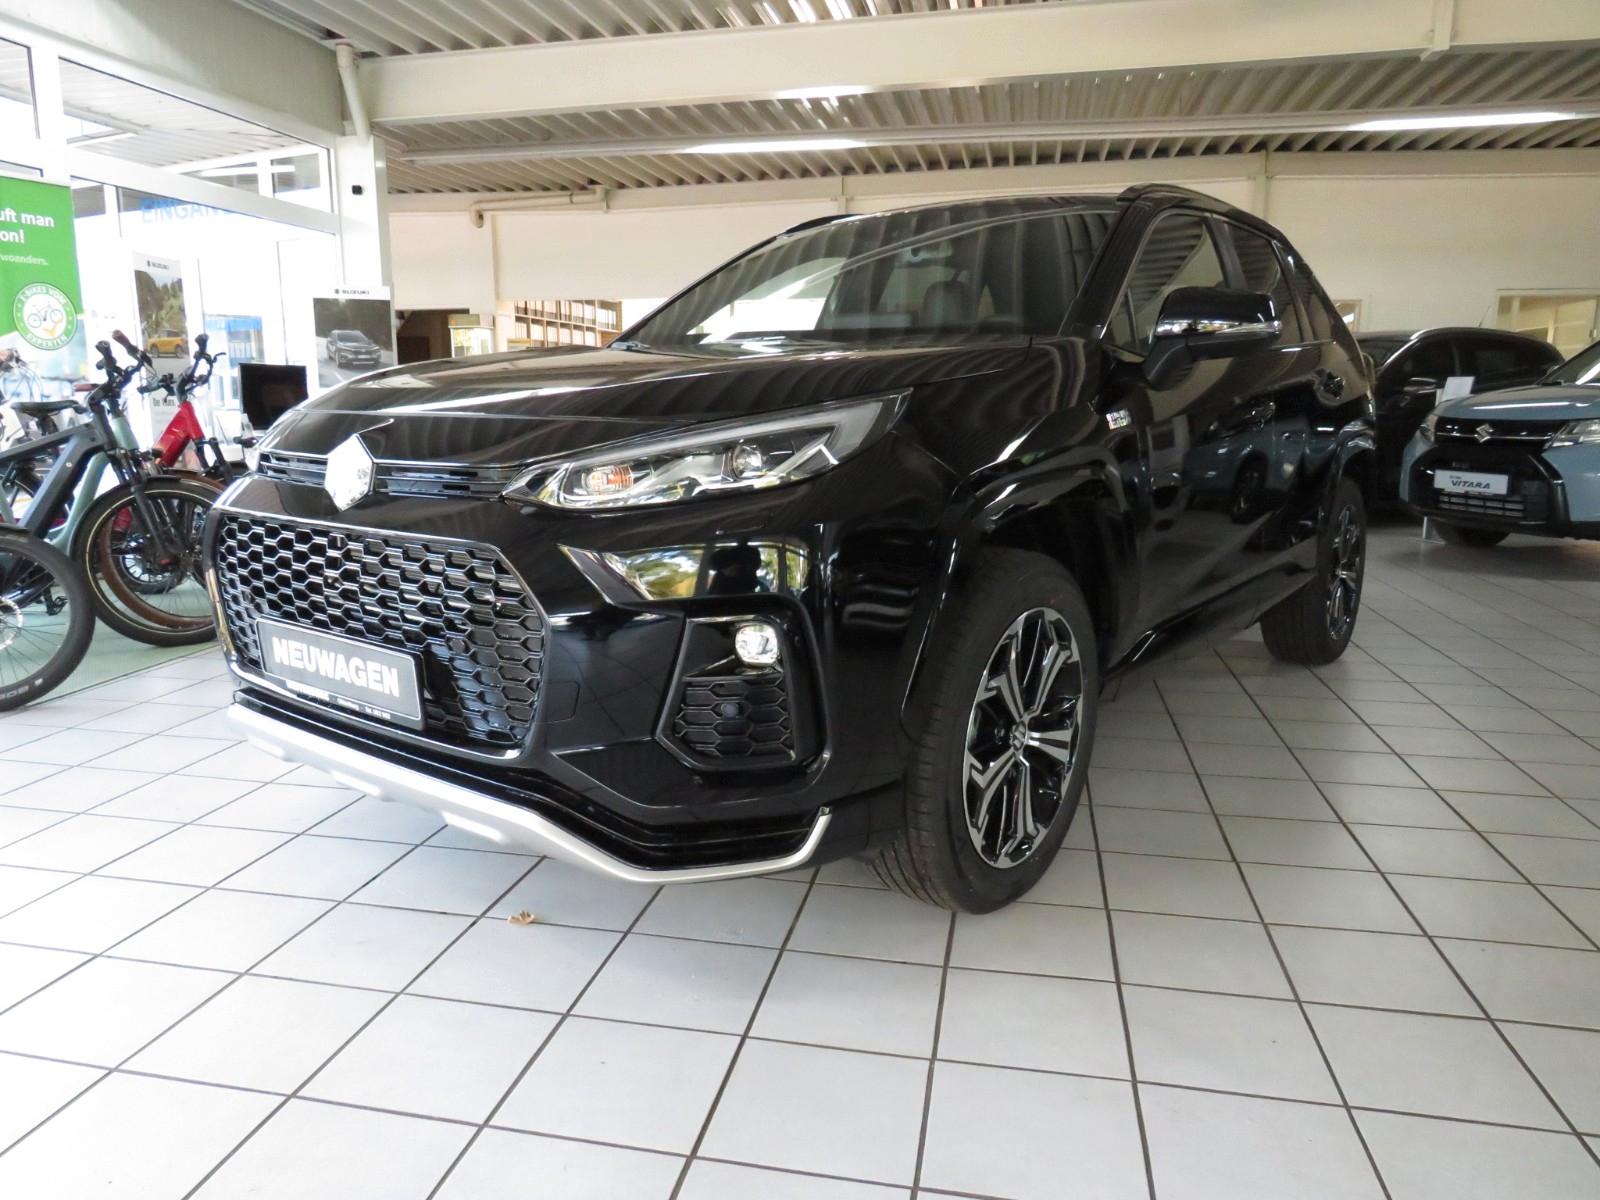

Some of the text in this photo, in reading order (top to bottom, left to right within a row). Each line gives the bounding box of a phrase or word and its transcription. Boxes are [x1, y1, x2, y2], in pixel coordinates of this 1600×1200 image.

[21, 213, 55, 228] man
[1451, 480, 1491, 489] VITARA
[271, 636, 400, 698] NEUWAGEN
